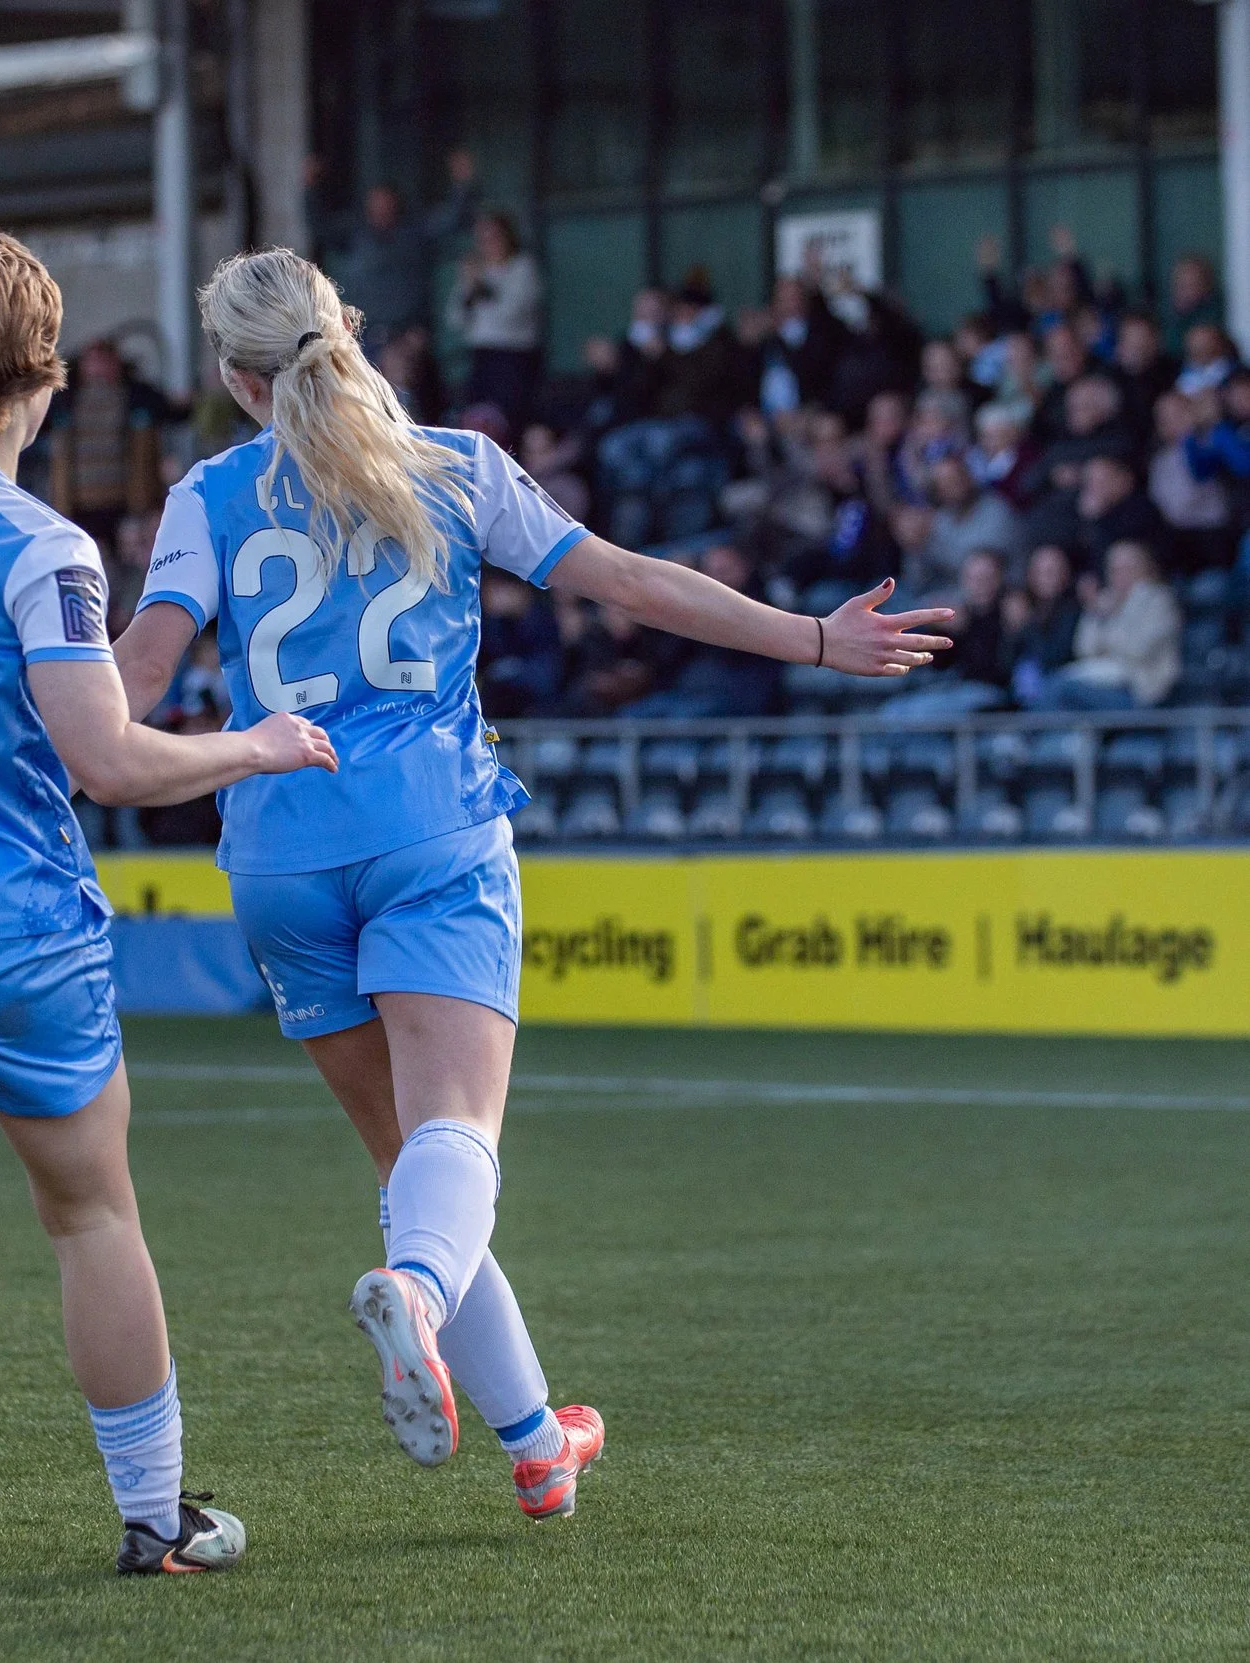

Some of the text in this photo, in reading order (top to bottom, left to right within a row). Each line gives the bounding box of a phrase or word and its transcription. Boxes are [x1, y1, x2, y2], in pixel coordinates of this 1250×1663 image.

[231, 517, 438, 715] 22
[735, 913, 842, 969] Grab
[855, 911, 952, 969] Hire
[1015, 911, 1216, 985] Haulage
